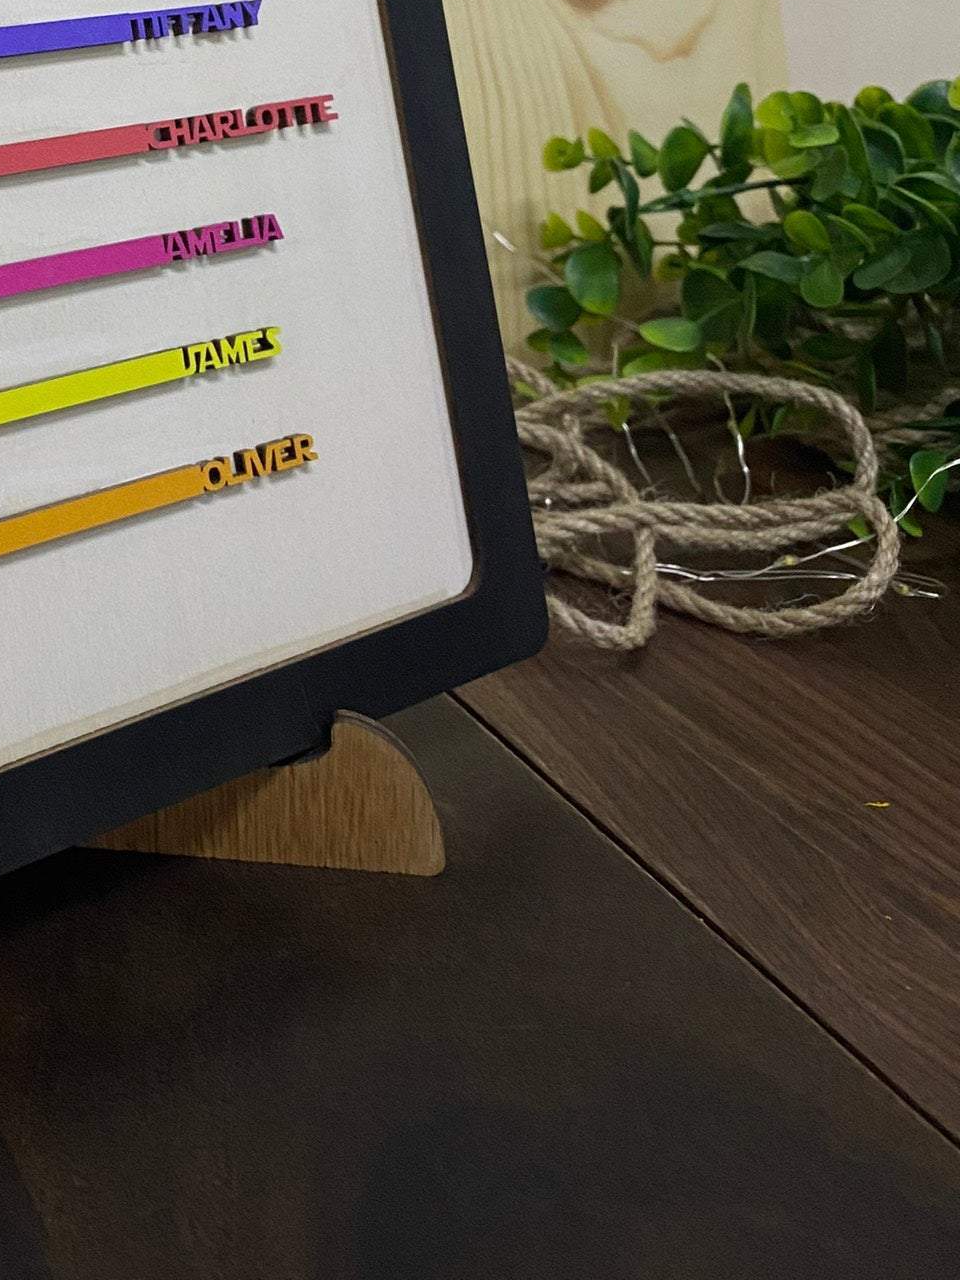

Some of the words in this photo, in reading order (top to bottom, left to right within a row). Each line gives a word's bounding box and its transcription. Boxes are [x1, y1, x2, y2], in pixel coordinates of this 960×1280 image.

[128, 0, 263, 42] TIFFANY
[146, 94, 338, 151] CHARLOTTE
[164, 214, 284, 261] AMELIA
[183, 326, 282, 375] JAMES
[201, 433, 319, 491] OLIVER
